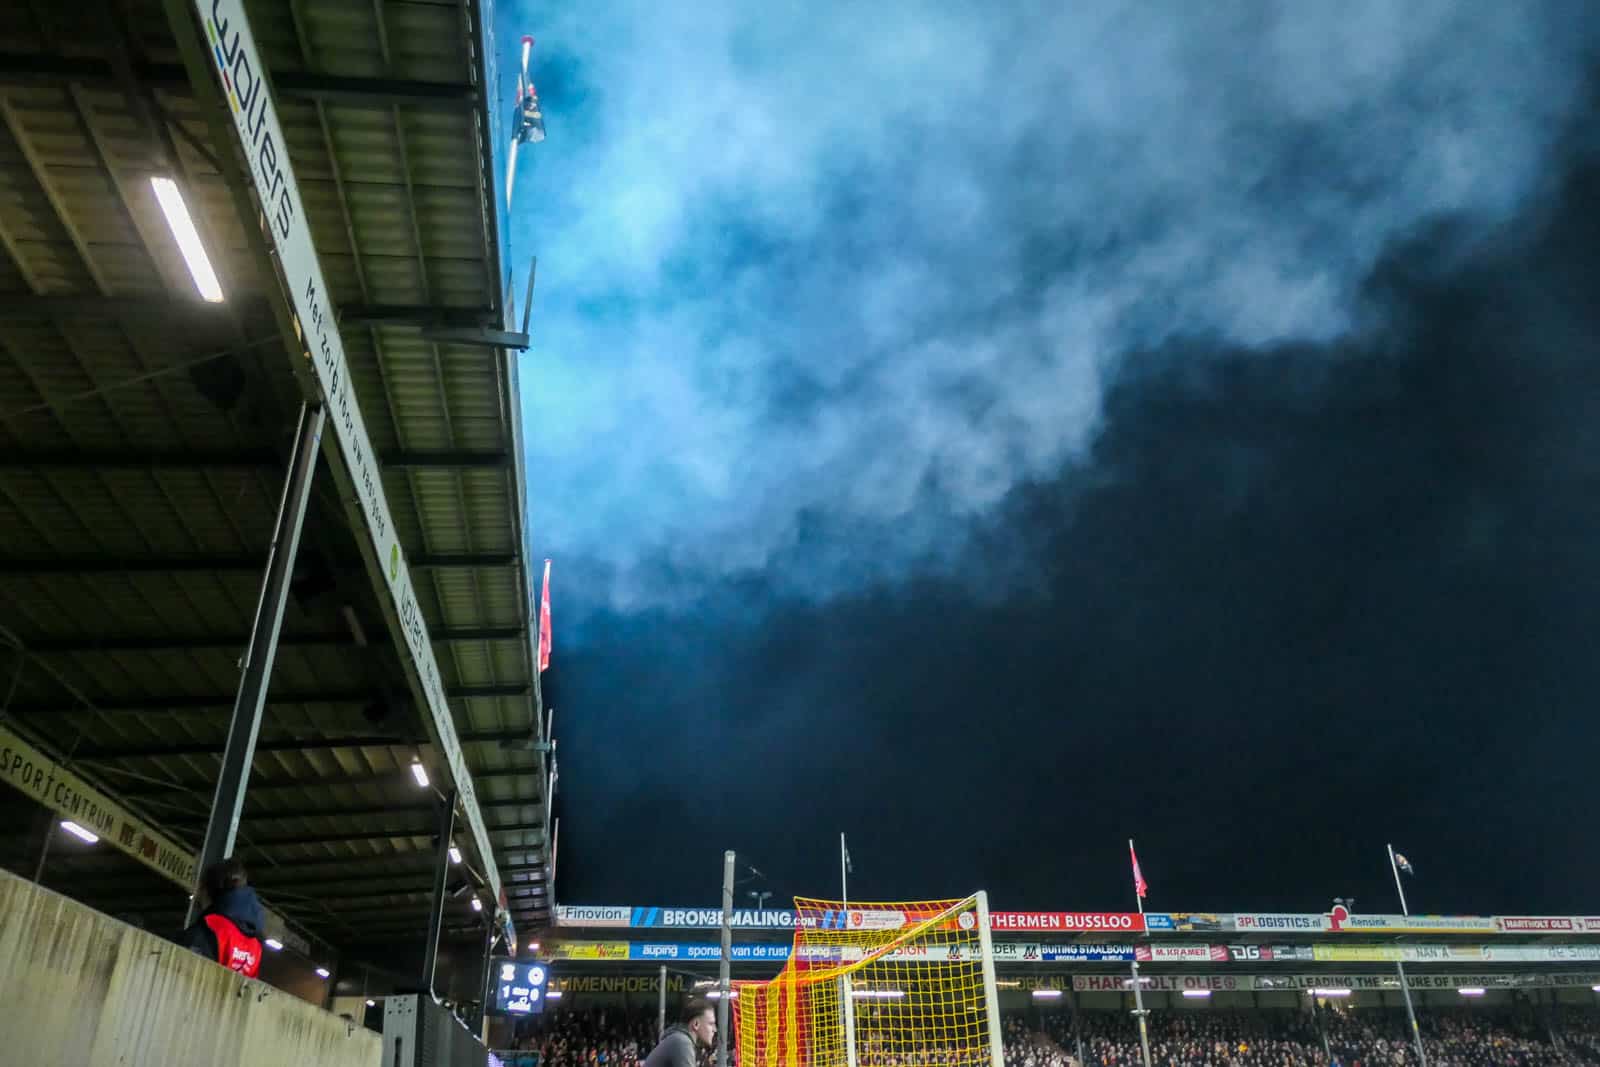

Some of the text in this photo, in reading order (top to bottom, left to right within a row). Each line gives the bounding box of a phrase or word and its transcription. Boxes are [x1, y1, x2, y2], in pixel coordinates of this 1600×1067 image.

[306, 277, 322, 331] Met
[320, 332, 340, 398] zorg
[1, 747, 115, 833] SPORTCENTRUM
[565, 907, 622, 919] Finovion
[989, 914, 1061, 928] THERMEN
[1065, 914, 1132, 928] BUSSLOO
[732, 947, 751, 956] van
[752, 945, 766, 956] de
[768, 945, 788, 956] rust
[1184, 976, 1222, 990] OLIE
[1299, 976, 1353, 988] LEADING
[1356, 976, 1379, 987] THE
[1383, 976, 1432, 988] FUURE
[1434, 976, 1449, 987] OF
